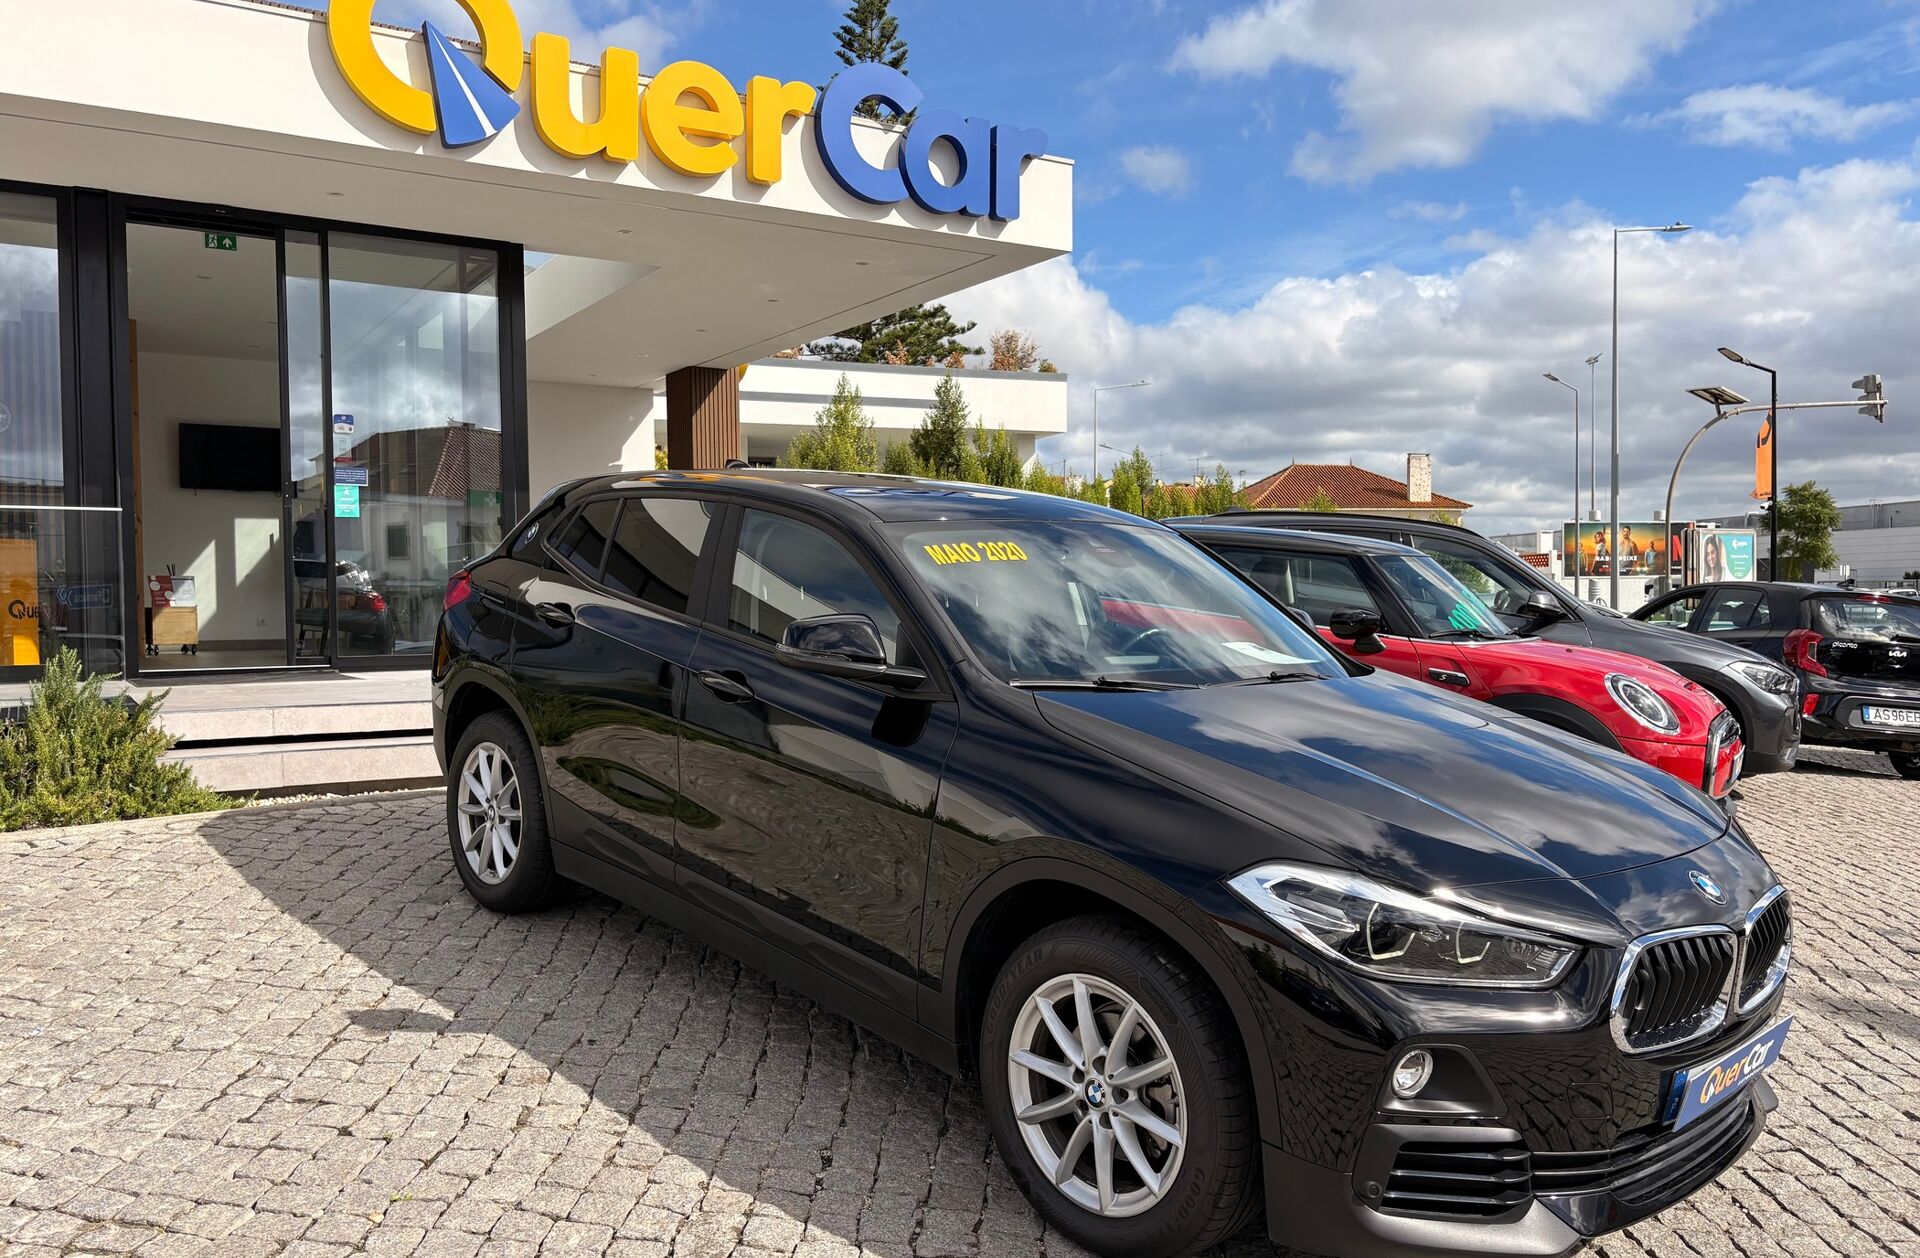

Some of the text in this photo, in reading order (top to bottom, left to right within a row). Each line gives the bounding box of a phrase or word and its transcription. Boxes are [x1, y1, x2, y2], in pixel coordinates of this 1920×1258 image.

[327, 0, 1048, 221] QuerCar
[923, 541, 1028, 565] MAIO 2020
[1832, 640, 1858, 649] picanto
[1700, 1040, 1774, 1104] QuerCar
